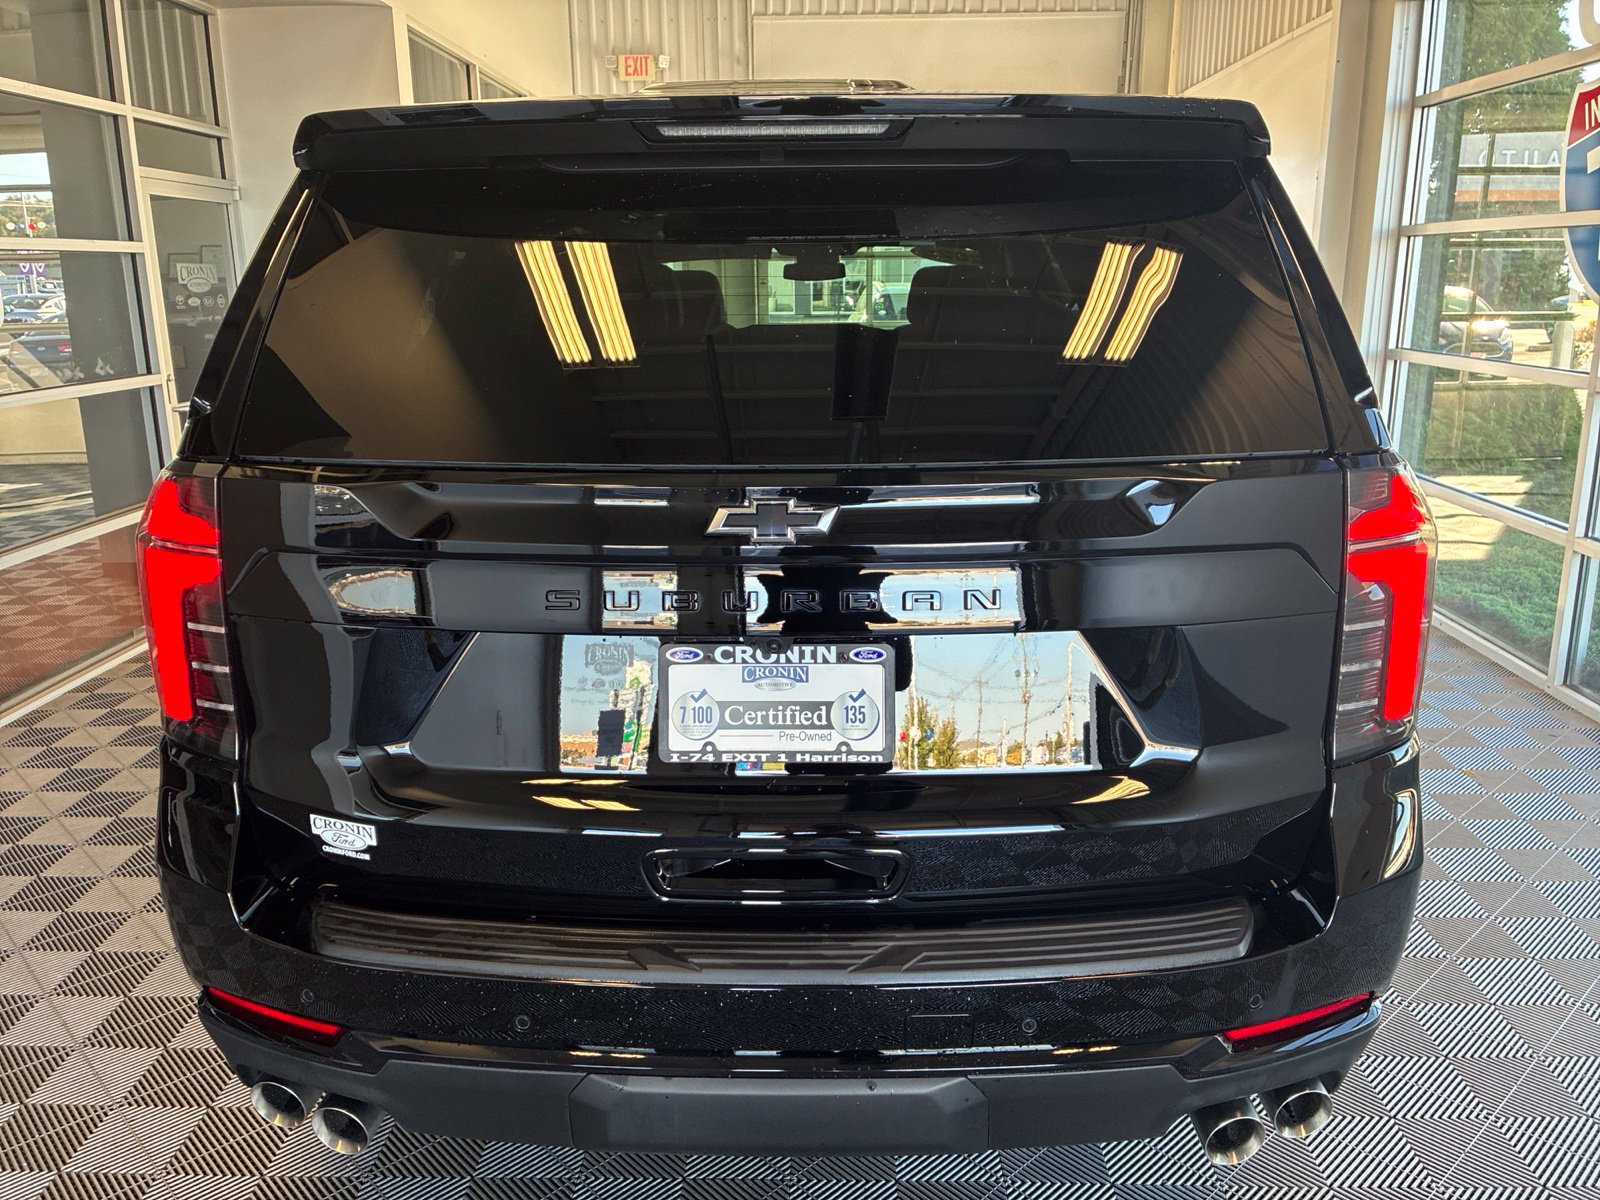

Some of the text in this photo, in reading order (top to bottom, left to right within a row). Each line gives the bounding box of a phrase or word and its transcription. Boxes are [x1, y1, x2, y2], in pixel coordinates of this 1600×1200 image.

[624, 55, 649, 76] EXIT
[180, 265, 216, 282] CRONIN
[545, 589, 1002, 612] SUBURBAN
[714, 645, 837, 664] CRONIN
[744, 666, 808, 682] CRONIN
[680, 706, 713, 724] 7 100
[724, 705, 828, 725] Certified
[844, 705, 866, 724] 135
[779, 730, 832, 742] Pre-Owned
[670, 752, 883, 762] I-74 EXIT 1 Harrison
[313, 816, 373, 841] CRONIN
[332, 832, 356, 847] Ford
